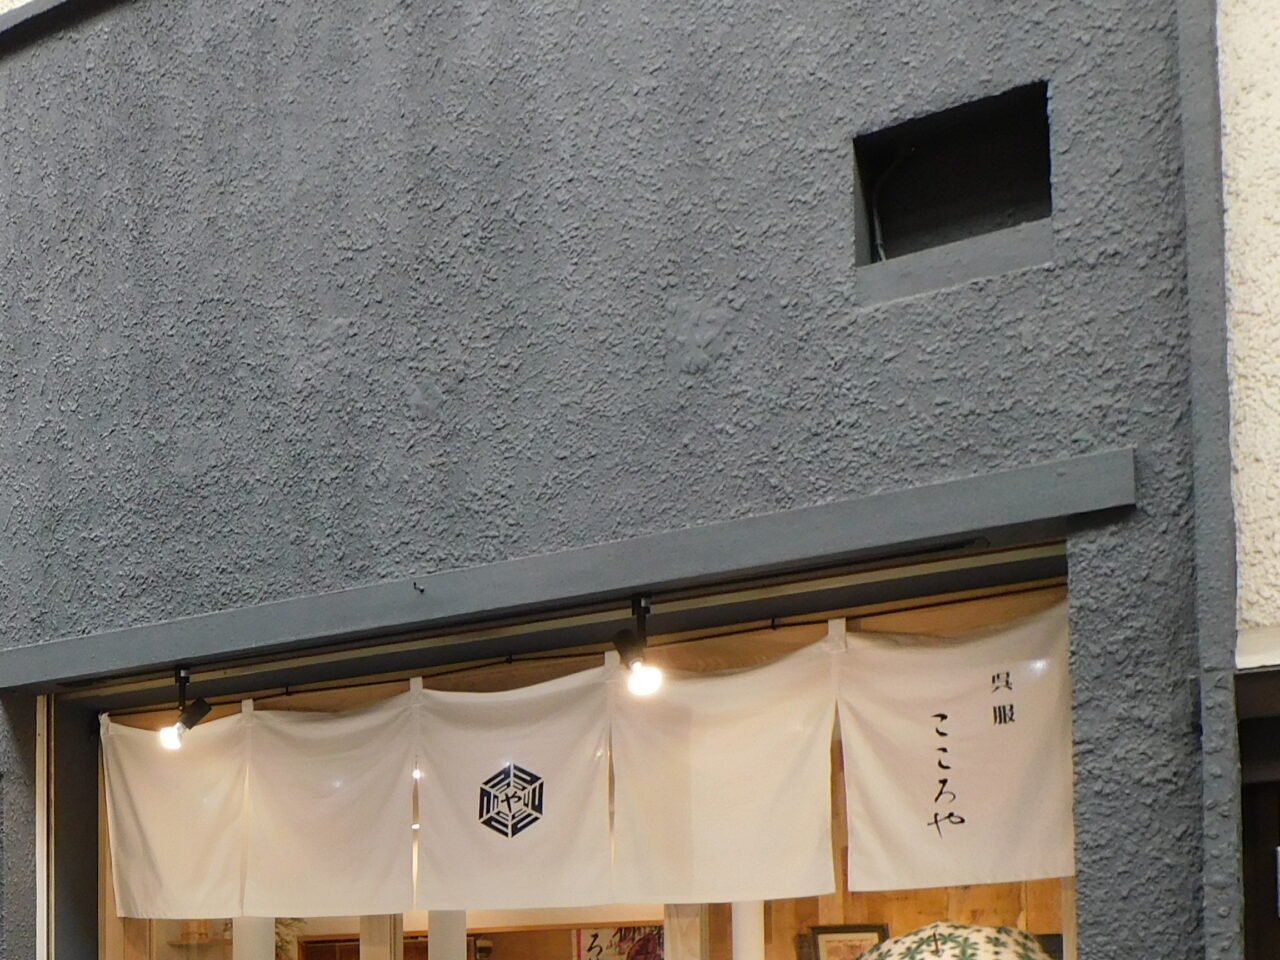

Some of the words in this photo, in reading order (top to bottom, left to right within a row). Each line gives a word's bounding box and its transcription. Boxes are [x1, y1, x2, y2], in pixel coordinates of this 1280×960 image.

[991, 671, 1015, 725] 呉服
[927, 713, 965, 839] こころや
